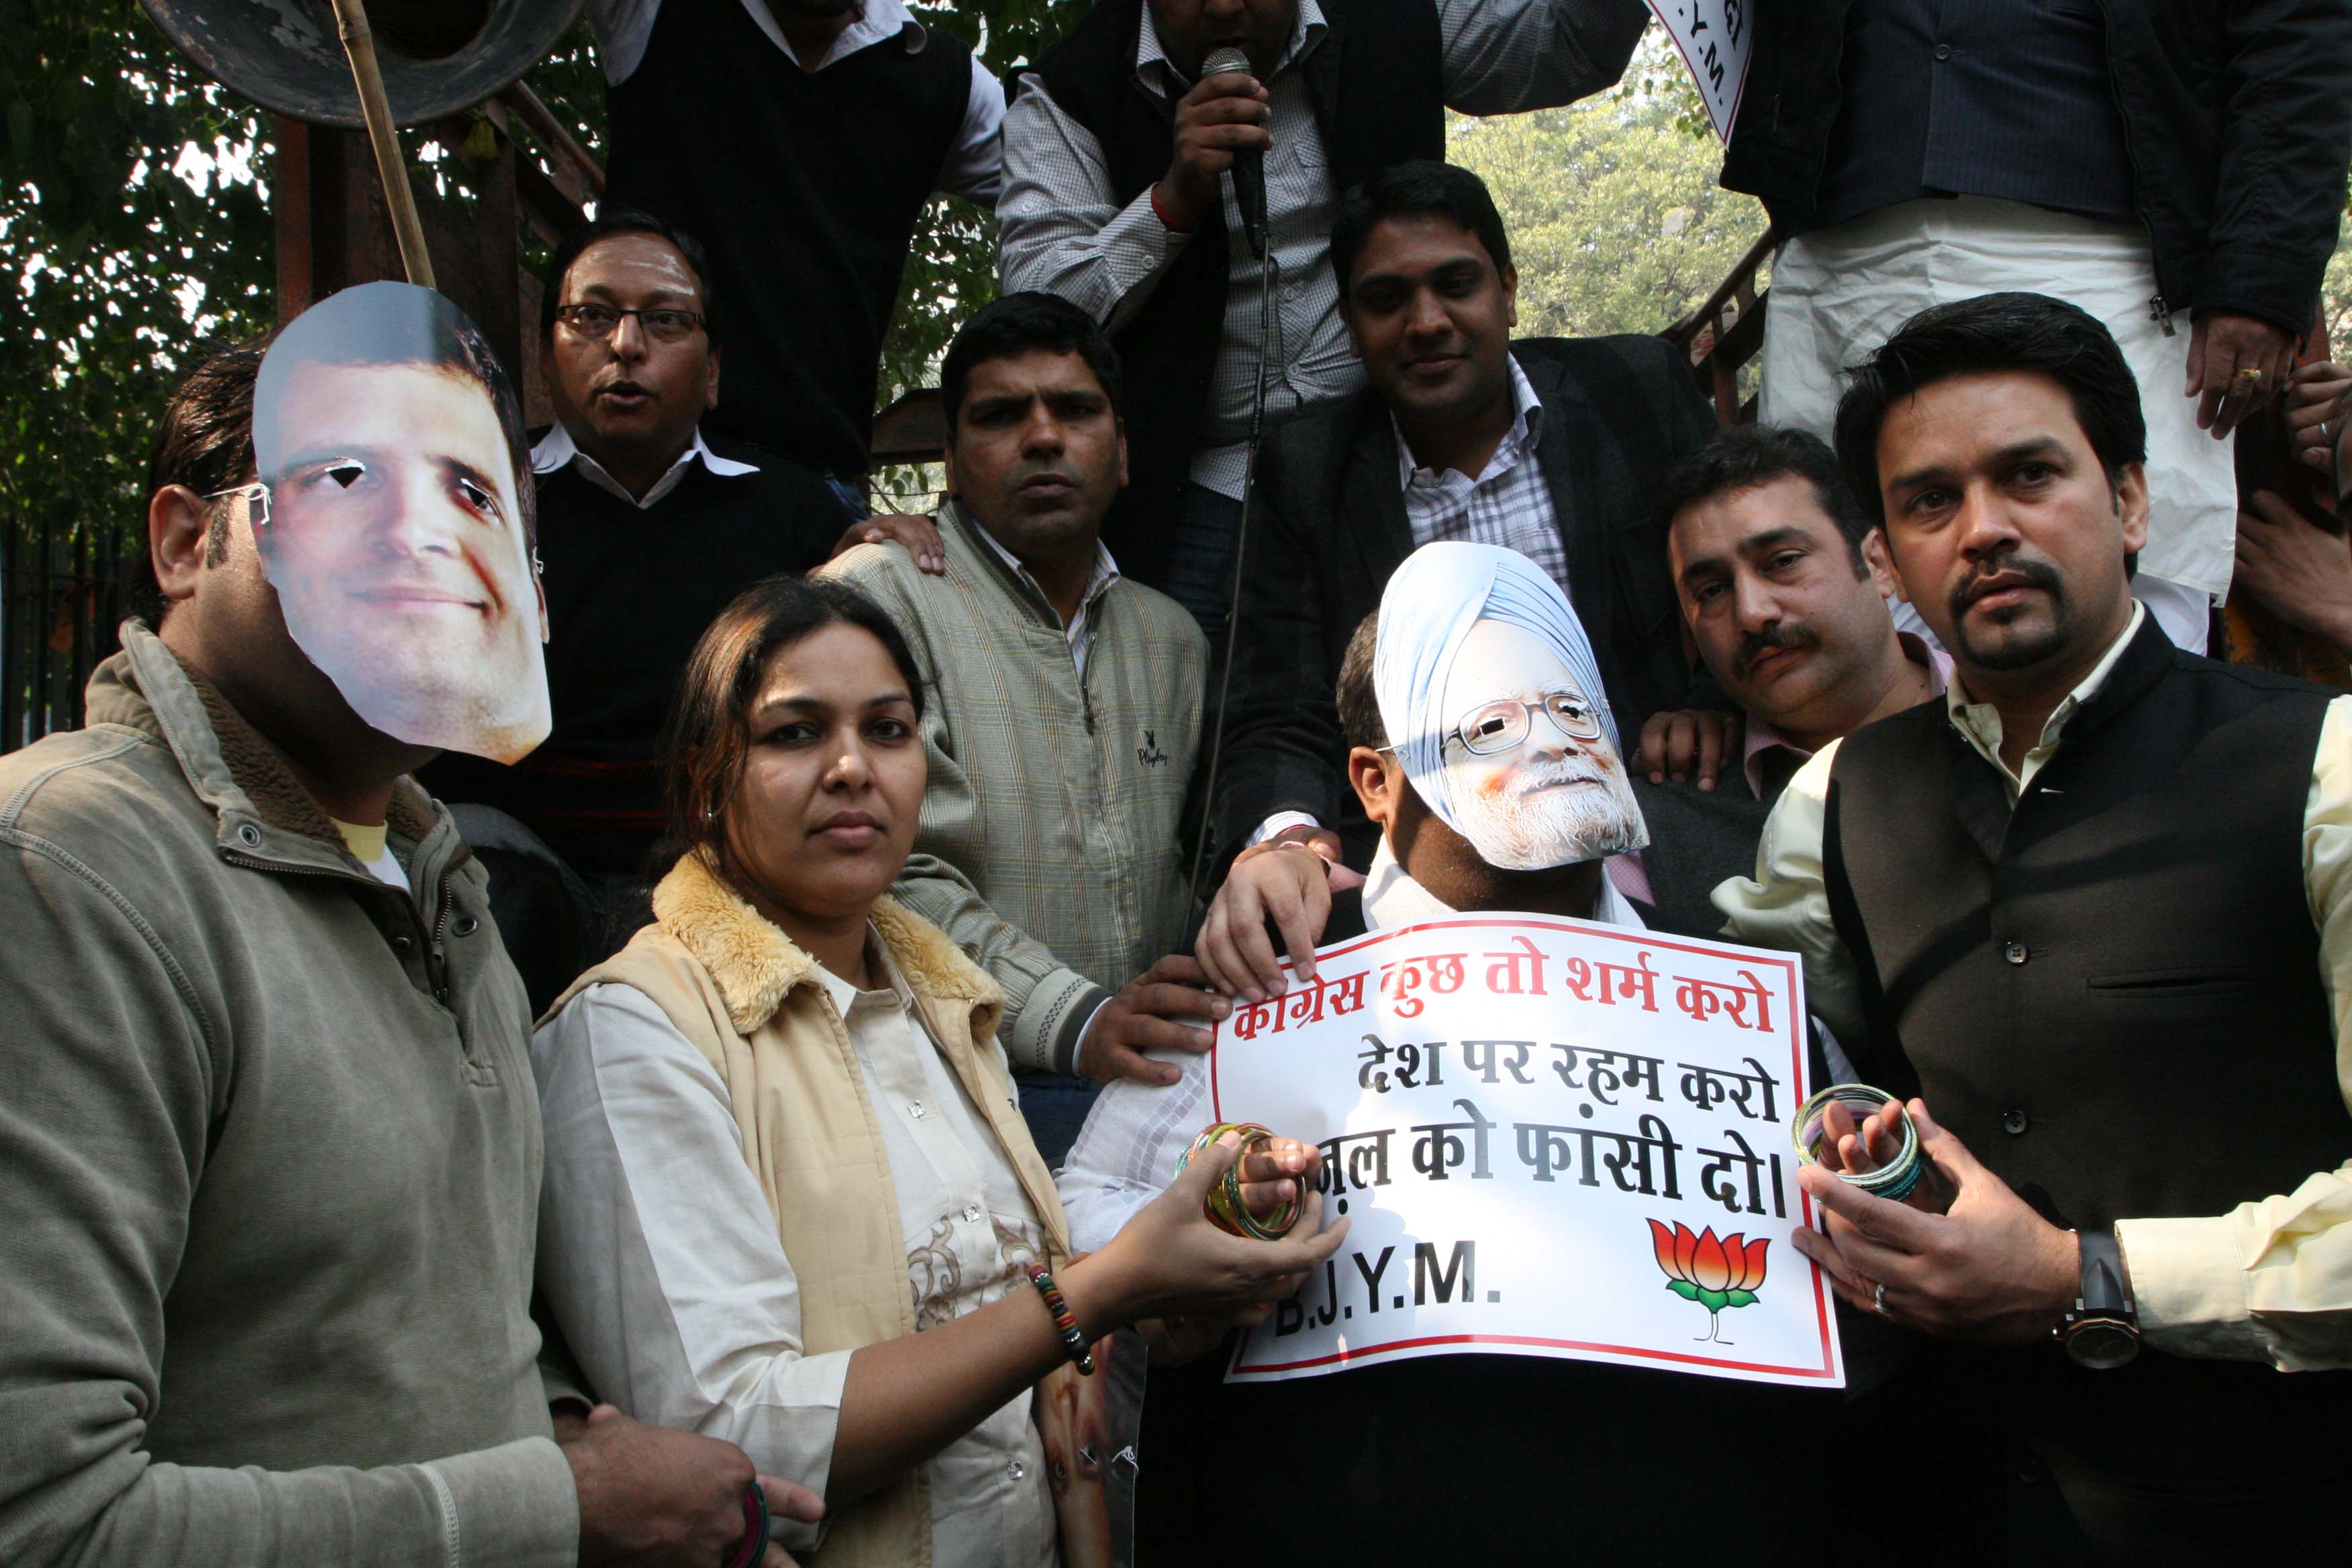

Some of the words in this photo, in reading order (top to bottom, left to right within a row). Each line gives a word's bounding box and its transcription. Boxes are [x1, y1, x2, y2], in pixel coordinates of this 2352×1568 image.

[1380, 953, 1469, 1018] कुछ
[1483, 936, 1551, 995] तो
[1565, 951, 1659, 1012] शर्म
[1672, 970, 1775, 1033] करो
[1357, 1034, 1447, 1093] देश
[1461, 1040, 1536, 1084] पर
[1551, 1043, 1665, 1106] रहम
[1677, 1057, 1781, 1123] करो
[1410, 1099, 1497, 1180] को
[1513, 1103, 1683, 1200] फांसी
